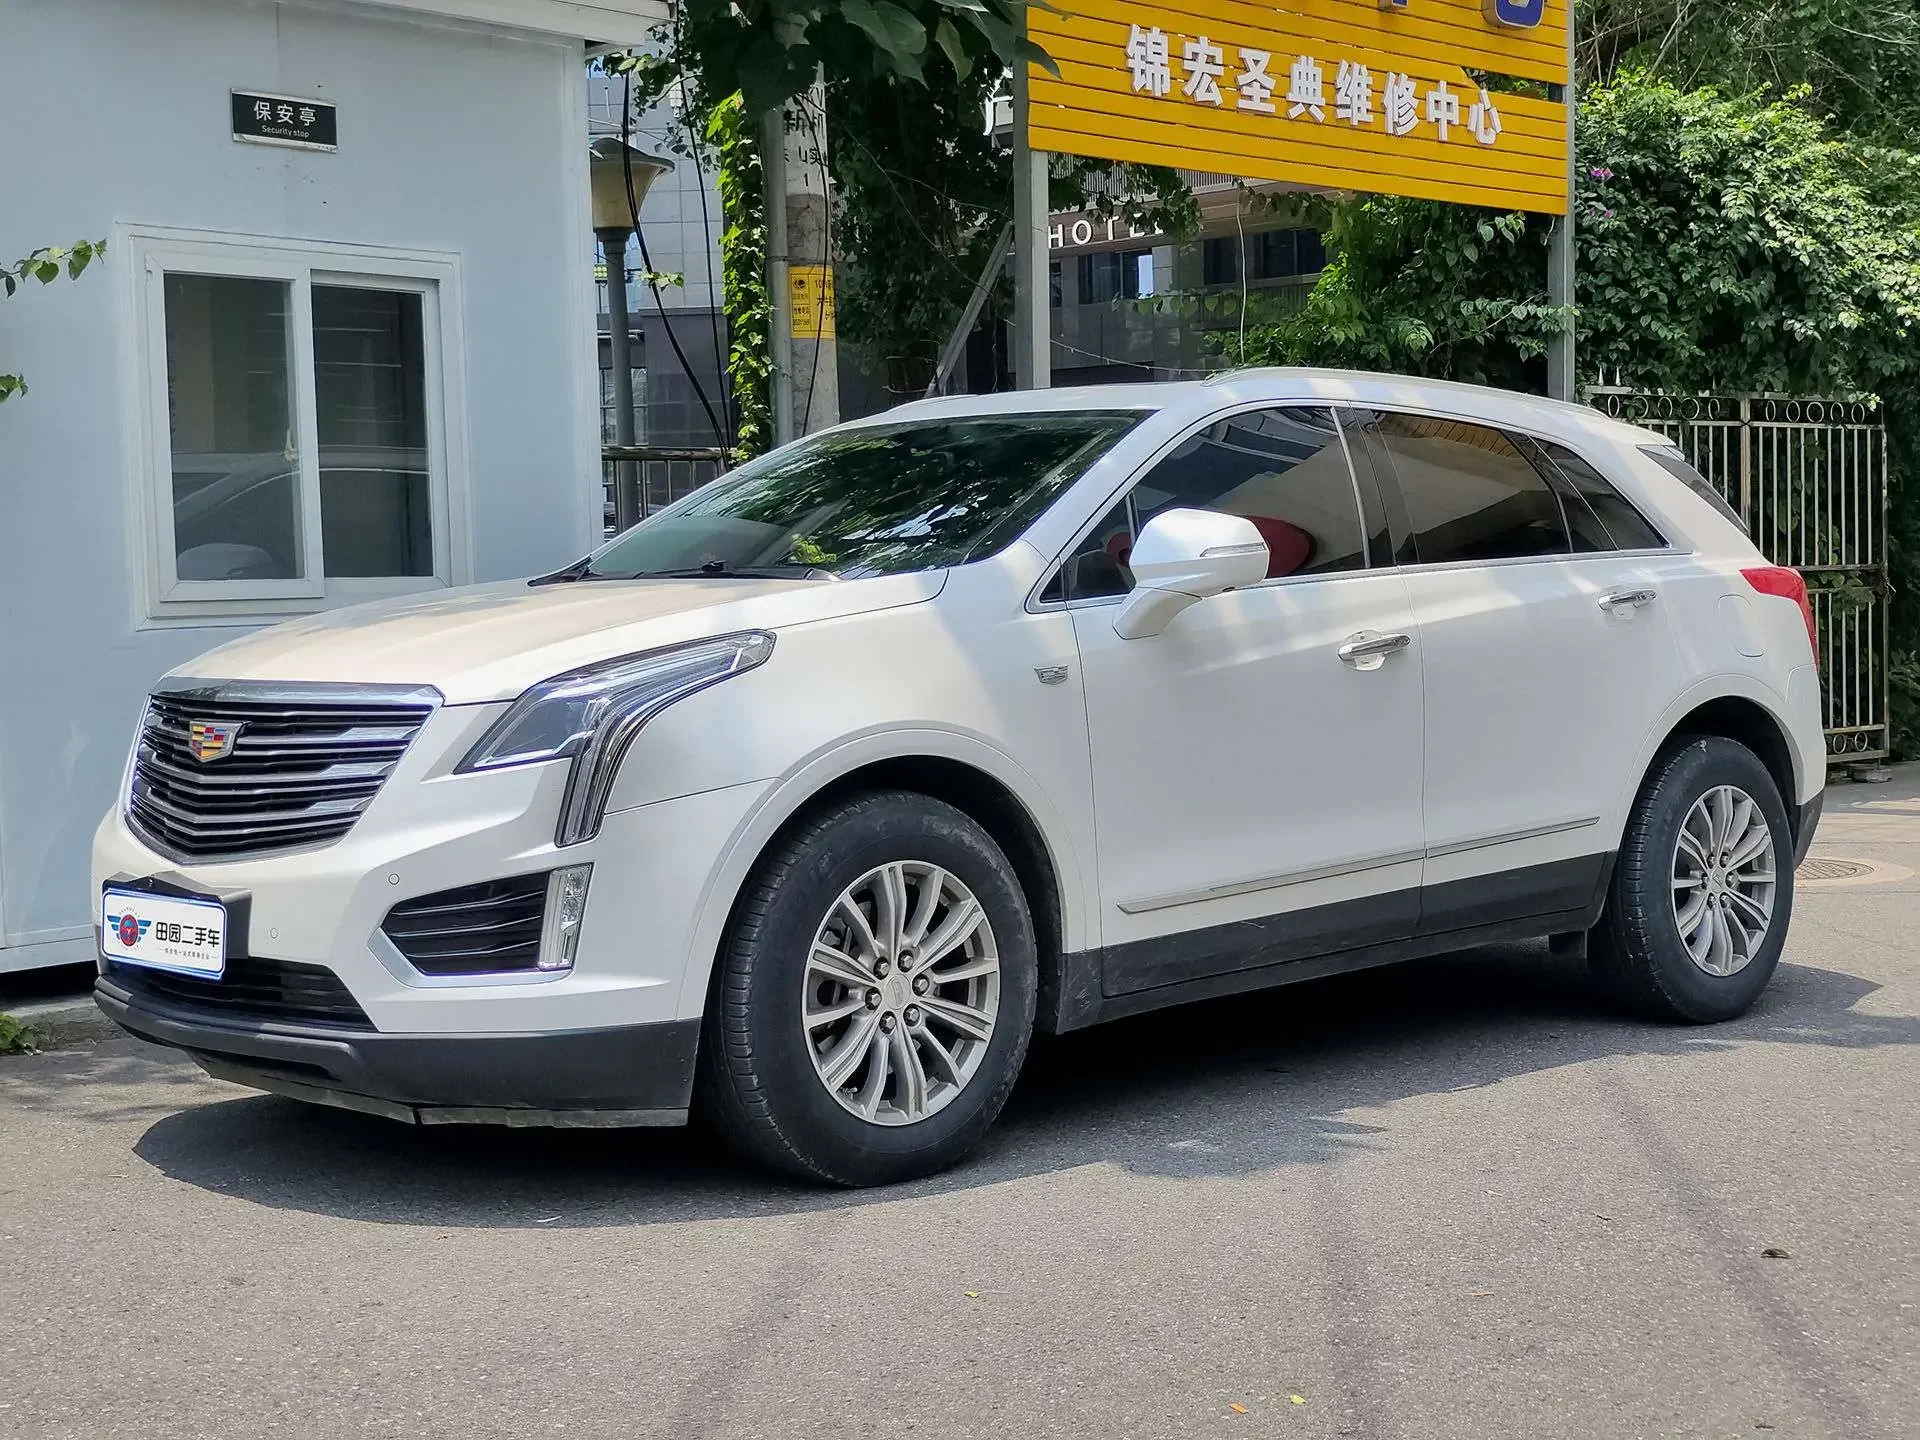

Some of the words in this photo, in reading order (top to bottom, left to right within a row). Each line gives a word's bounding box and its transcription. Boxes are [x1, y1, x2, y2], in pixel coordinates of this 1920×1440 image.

[1125, 23, 1503, 145] 锦宏圣典维修中心
[253, 100, 316, 126] 保安亭
[261, 124, 292, 137] Security
[293, 128, 310, 139] stop
[1048, 211, 1164, 249] HOTE
[155, 922, 220, 948] 田园二手车
